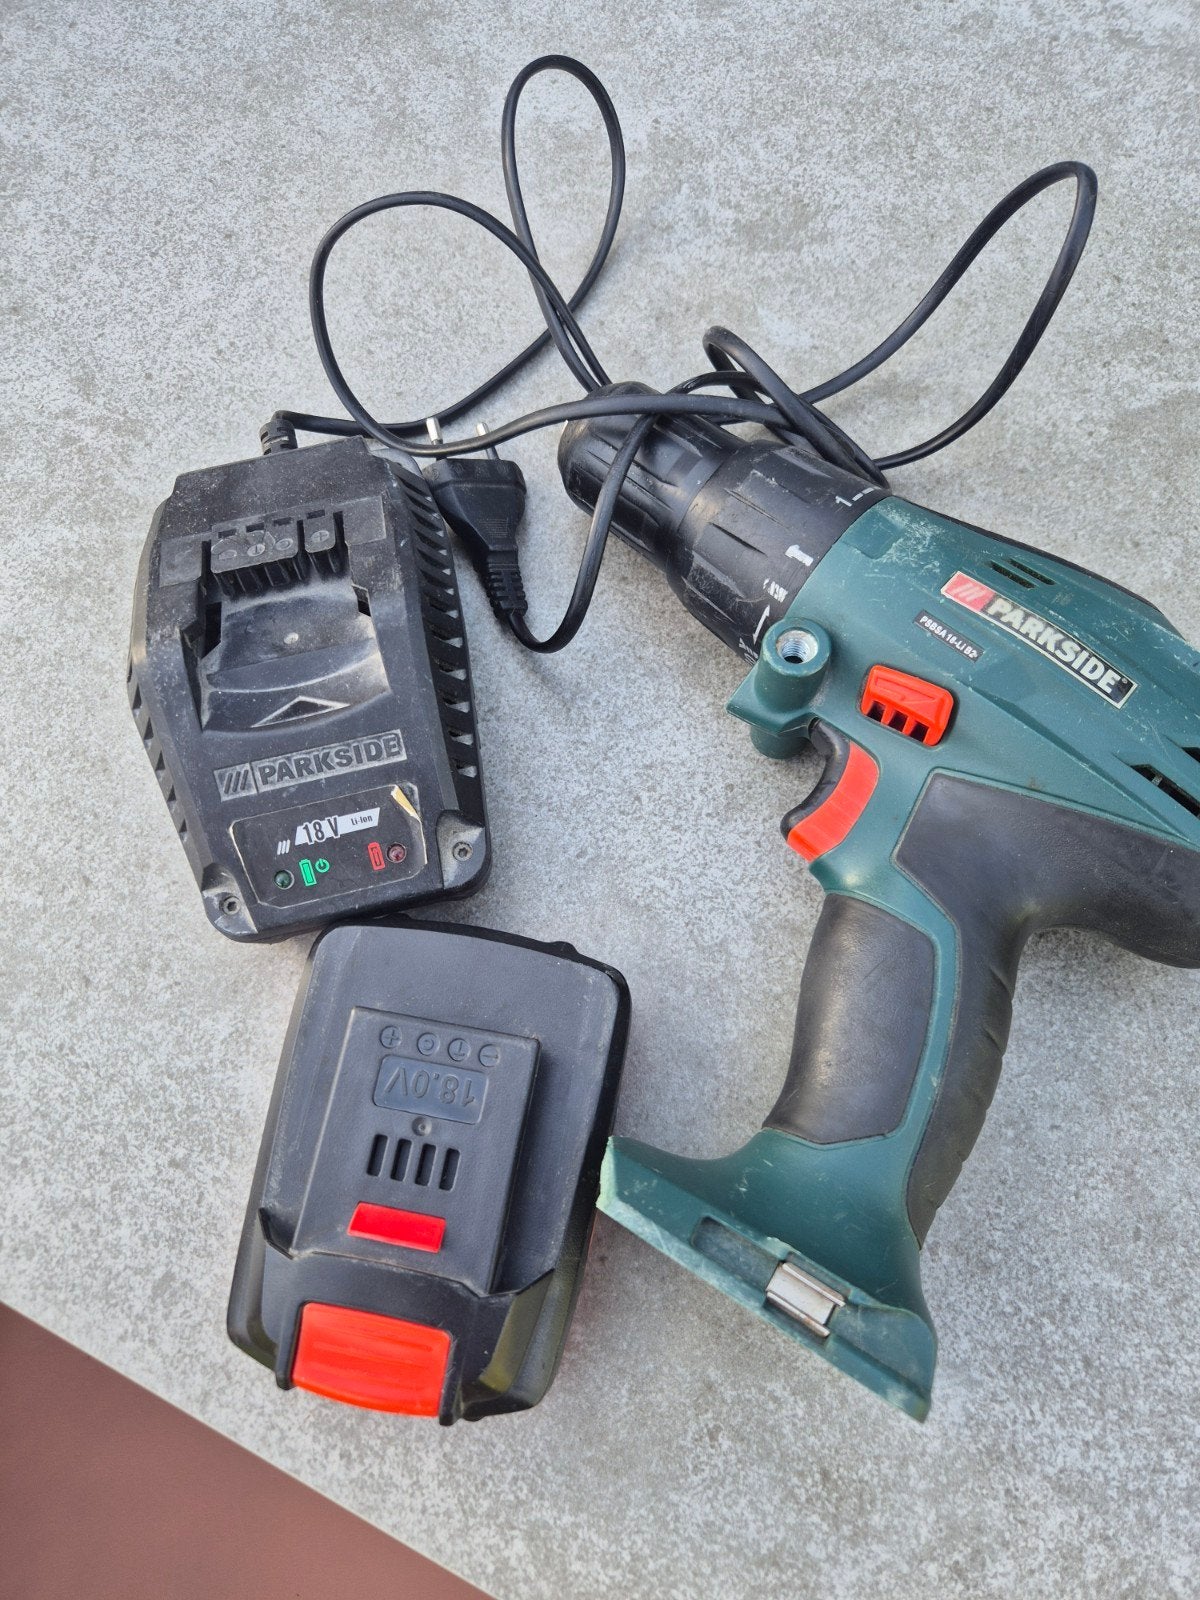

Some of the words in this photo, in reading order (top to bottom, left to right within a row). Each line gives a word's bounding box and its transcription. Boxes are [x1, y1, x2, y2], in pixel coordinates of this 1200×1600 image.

[919, 616, 947, 638] PSBSA
[987, 598, 1121, 693] PARKSIDE
[258, 734, 401, 786] PARKSIDE
[302, 819, 326, 844] 18
[327, 816, 340, 838] V
[350, 814, 373, 826] Li-Ion
[383, 1066, 475, 1107] 18.0V
